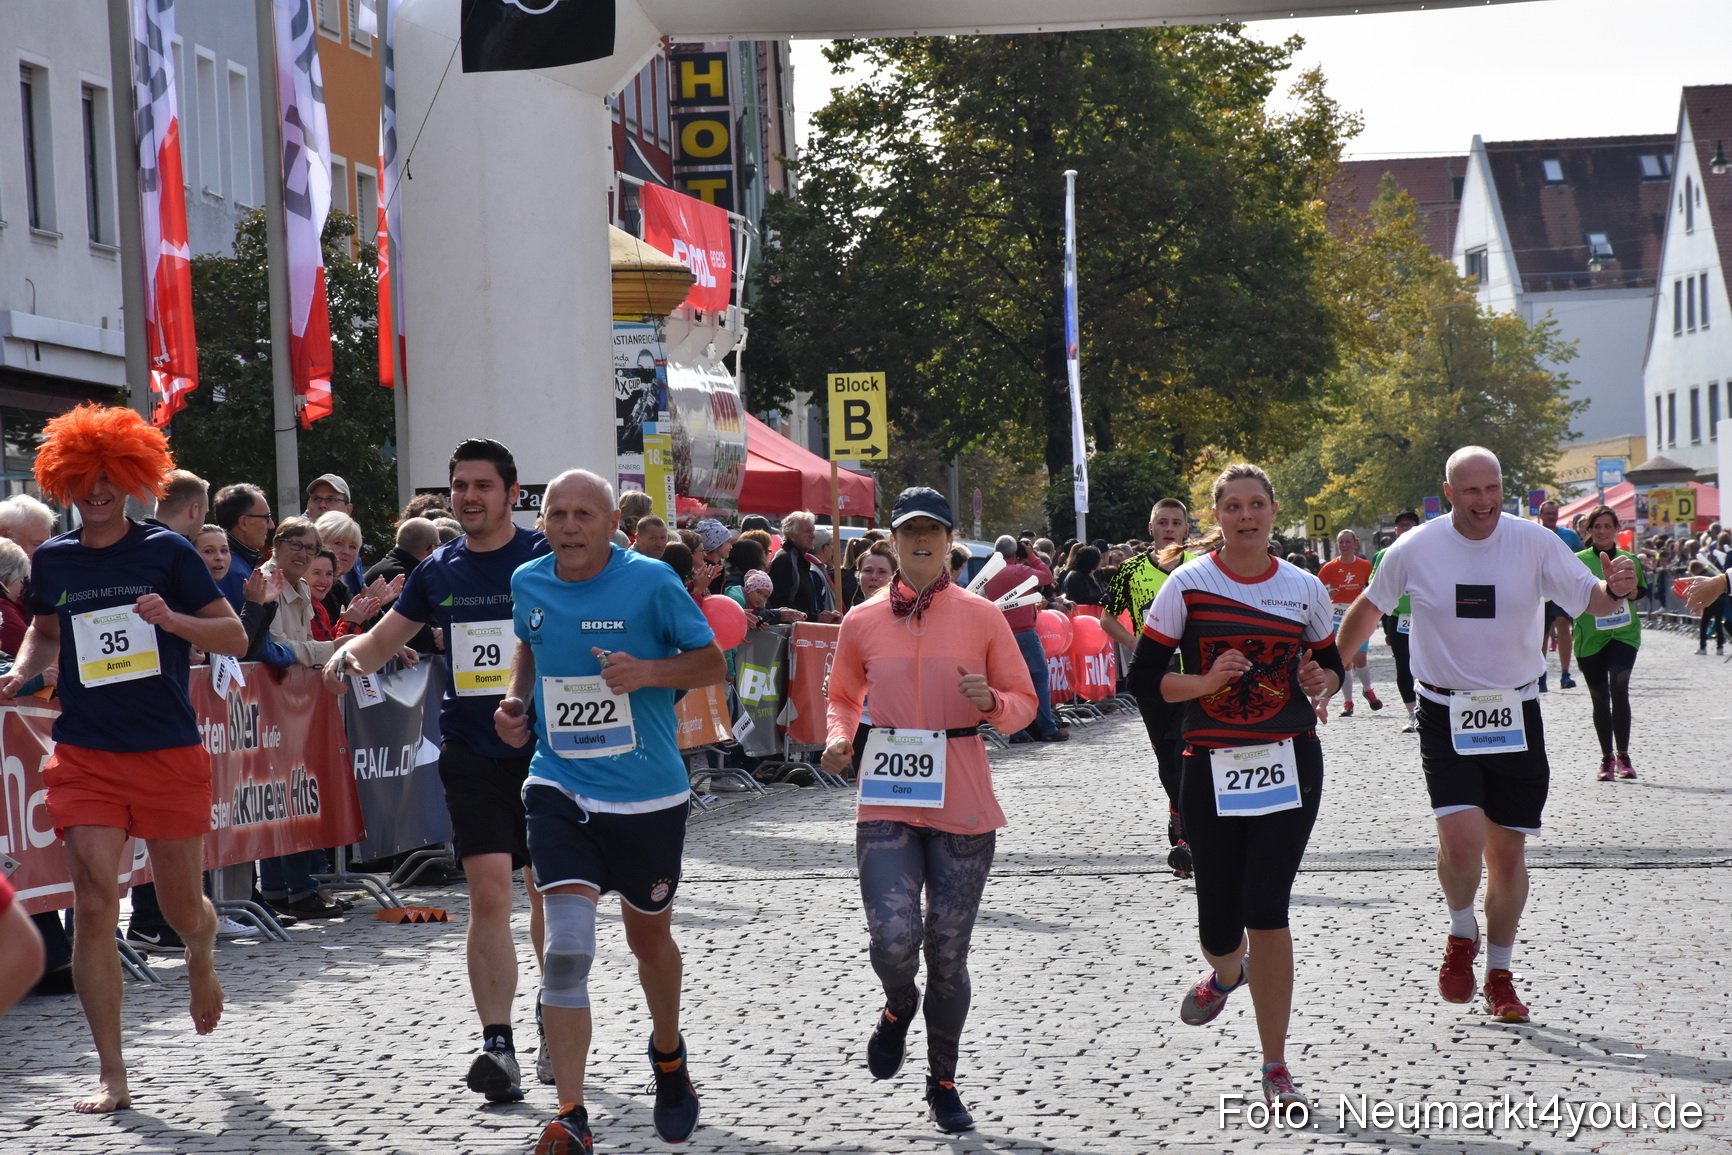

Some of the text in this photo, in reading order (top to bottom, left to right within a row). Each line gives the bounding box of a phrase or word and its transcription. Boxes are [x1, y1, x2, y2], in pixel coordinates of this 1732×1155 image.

[681, 60, 729, 204] HOT
[629, 379, 640, 391] CUP
[835, 376, 879, 392] Block
[844, 399, 873, 441] B
[647, 449, 662, 464] 18.
[1679, 499, 1691, 515] D
[1314, 514, 1326, 531] D
[67, 586, 153, 603] GOSSEN METRAWATT
[454, 596, 485, 606] GOSSEN
[1261, 599, 1302, 608] NEUMARKT
[100, 612, 129, 624] BOCK
[581, 621, 625, 630] BOCK
[100, 630, 130, 655] 35
[473, 644, 501, 667] 29
[107, 660, 131, 671] Armin
[475, 675, 502, 683] Roman
[571, 683, 601, 691] BOCK
[1479, 694, 1503, 702] BOCK
[227, 690, 259, 751] 80er
[557, 700, 618, 727] 2222
[1461, 707, 1513, 730] 2048
[574, 734, 606, 745] Ludwig
[1471, 733, 1506, 744] Wolfgang
[1241, 749, 1270, 760] BOCK
[873, 752, 934, 778] 2039
[1225, 763, 1285, 791] 2726
[290, 764, 320, 818] Hits
[892, 784, 912, 794] Caro
